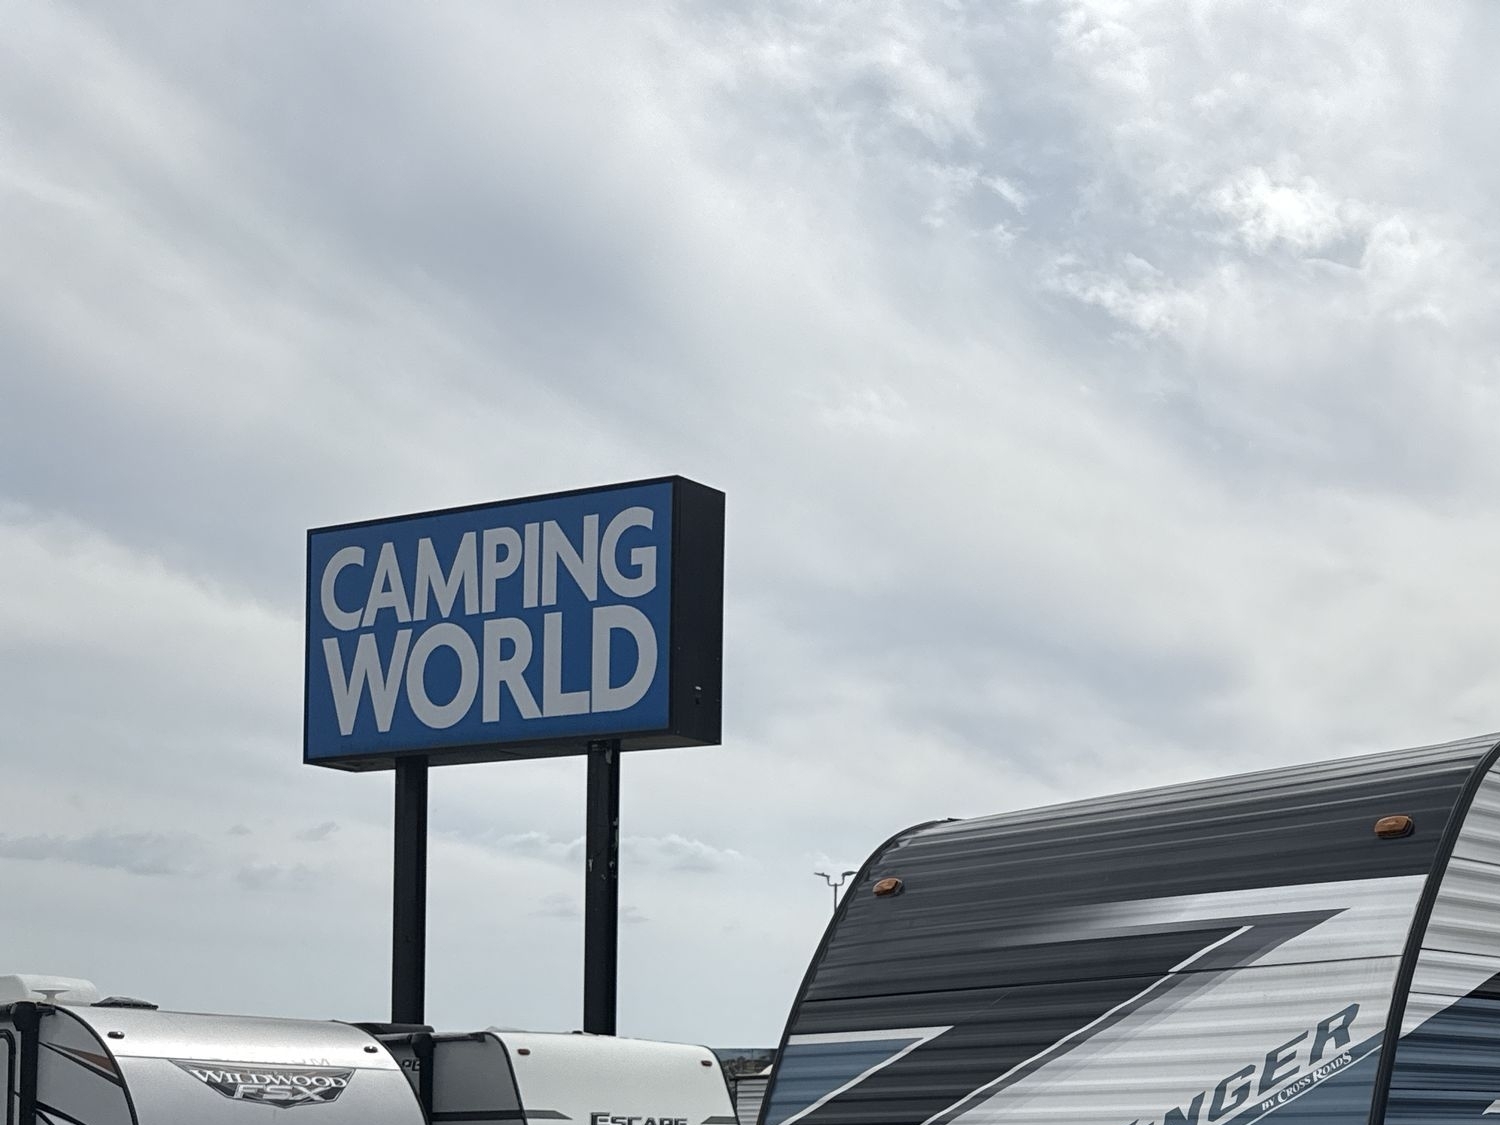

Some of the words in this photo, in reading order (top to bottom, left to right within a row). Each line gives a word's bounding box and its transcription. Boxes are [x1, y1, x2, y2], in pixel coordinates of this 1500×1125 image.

[320, 506, 657, 631] CAMPING
[322, 604, 658, 736] WORLD
[189, 1069, 348, 1088] WILDWOOD
[233, 1083, 332, 1101] FSX
[1262, 1097, 1275, 1111] BY
[1277, 1076, 1311, 1102] CROSS
[1312, 1050, 1352, 1082] ROADS
